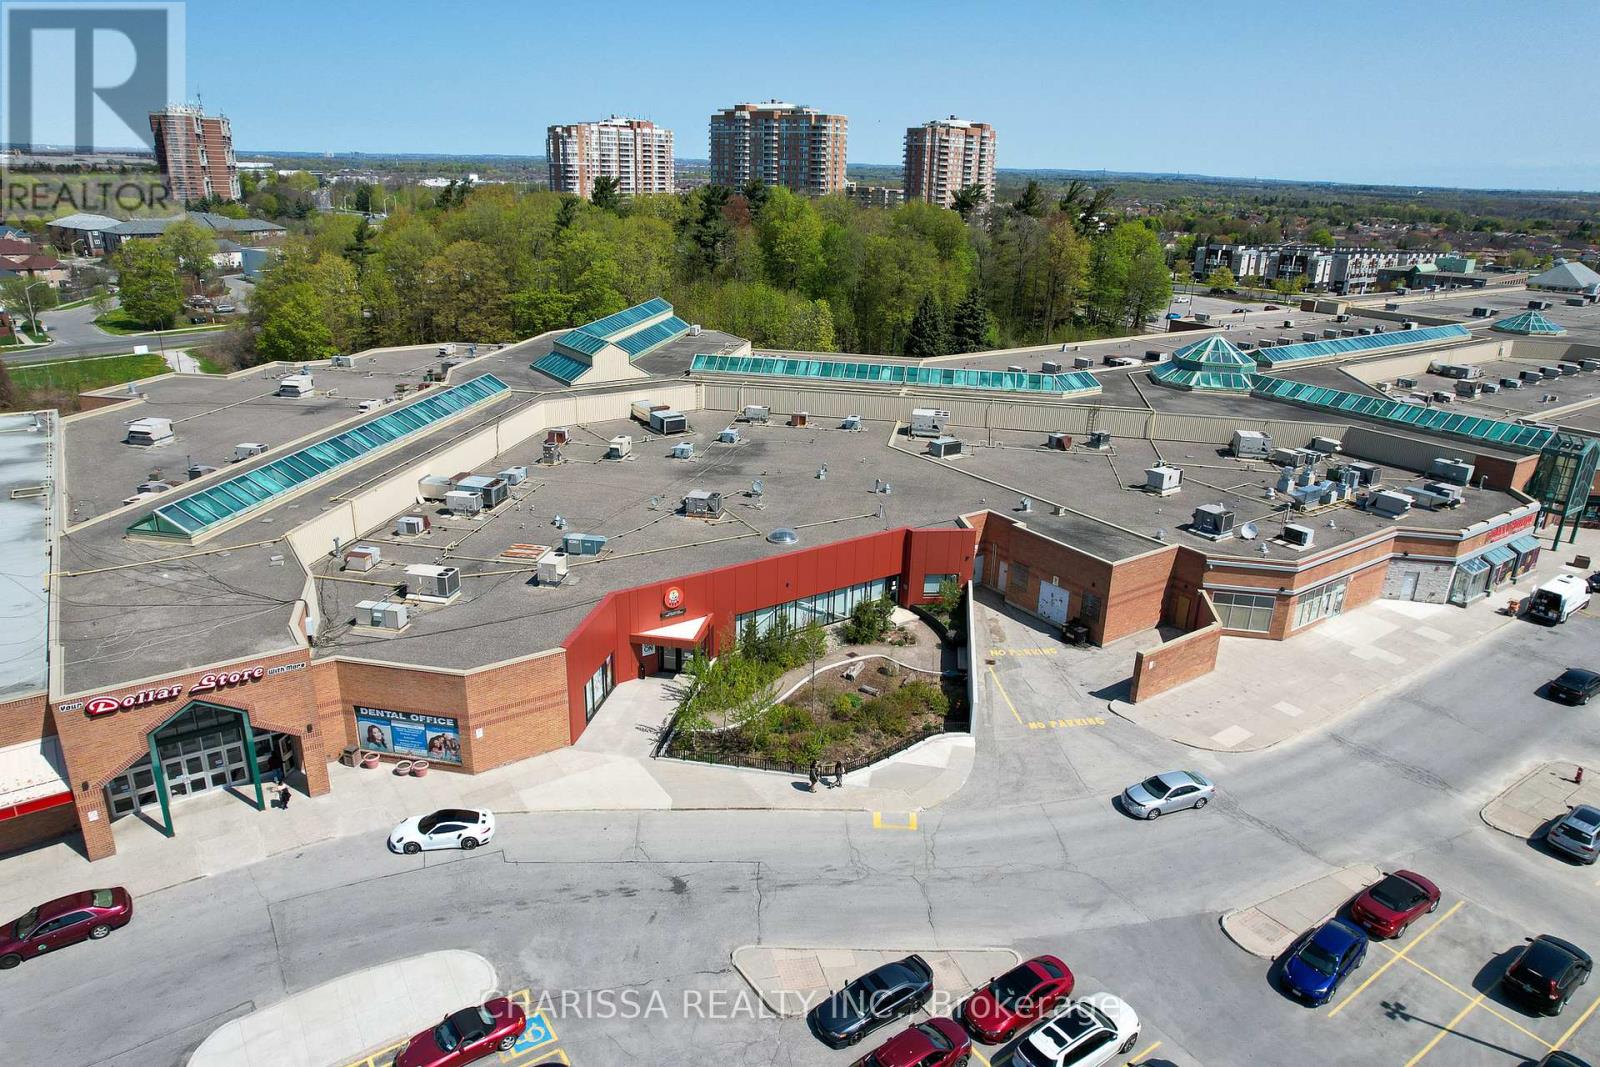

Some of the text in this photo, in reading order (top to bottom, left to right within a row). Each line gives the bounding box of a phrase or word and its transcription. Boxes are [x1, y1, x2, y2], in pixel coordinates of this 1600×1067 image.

[990, 649, 1006, 657] NO
[86, 686, 183, 714] Dollar
[189, 667, 264, 694] Store
[360, 707, 455, 726] DENTAL OFFICE
[1049, 717, 1105, 729] PARKING
